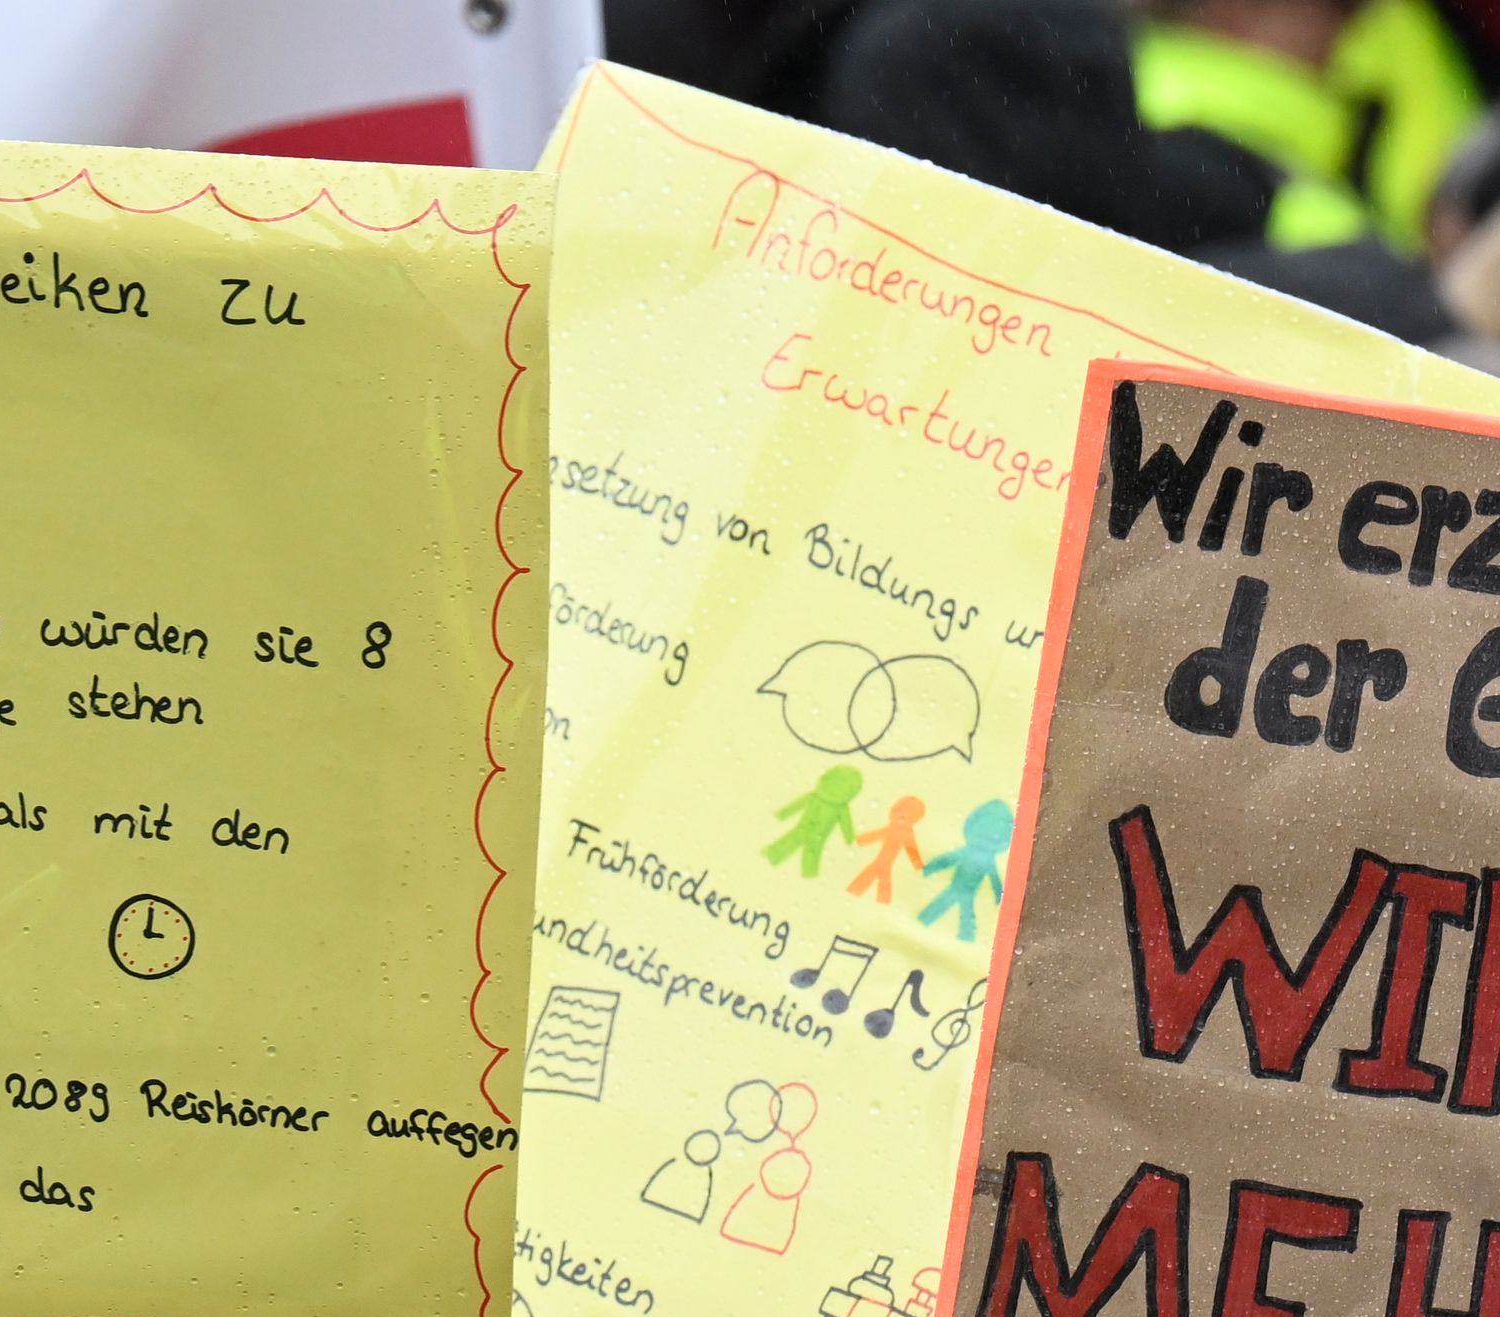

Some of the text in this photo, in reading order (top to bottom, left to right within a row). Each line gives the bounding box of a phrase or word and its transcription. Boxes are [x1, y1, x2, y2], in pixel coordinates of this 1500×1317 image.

[711, 170, 1052, 356] Anforderungen
[220, 278, 306, 325] zu
[1108, 380, 1314, 557] Wir
[717, 512, 772, 556] von
[804, 524, 980, 641] Bildungs
[254, 626, 320, 669] sie
[361, 621, 394, 670] 8
[1164, 576, 1408, 752] der
[68, 675, 204, 726] stehen
[94, 804, 172, 846] mit
[211, 809, 290, 857] den
[366, 1107, 519, 1158] auffegen
[19, 1174, 97, 1213] das
